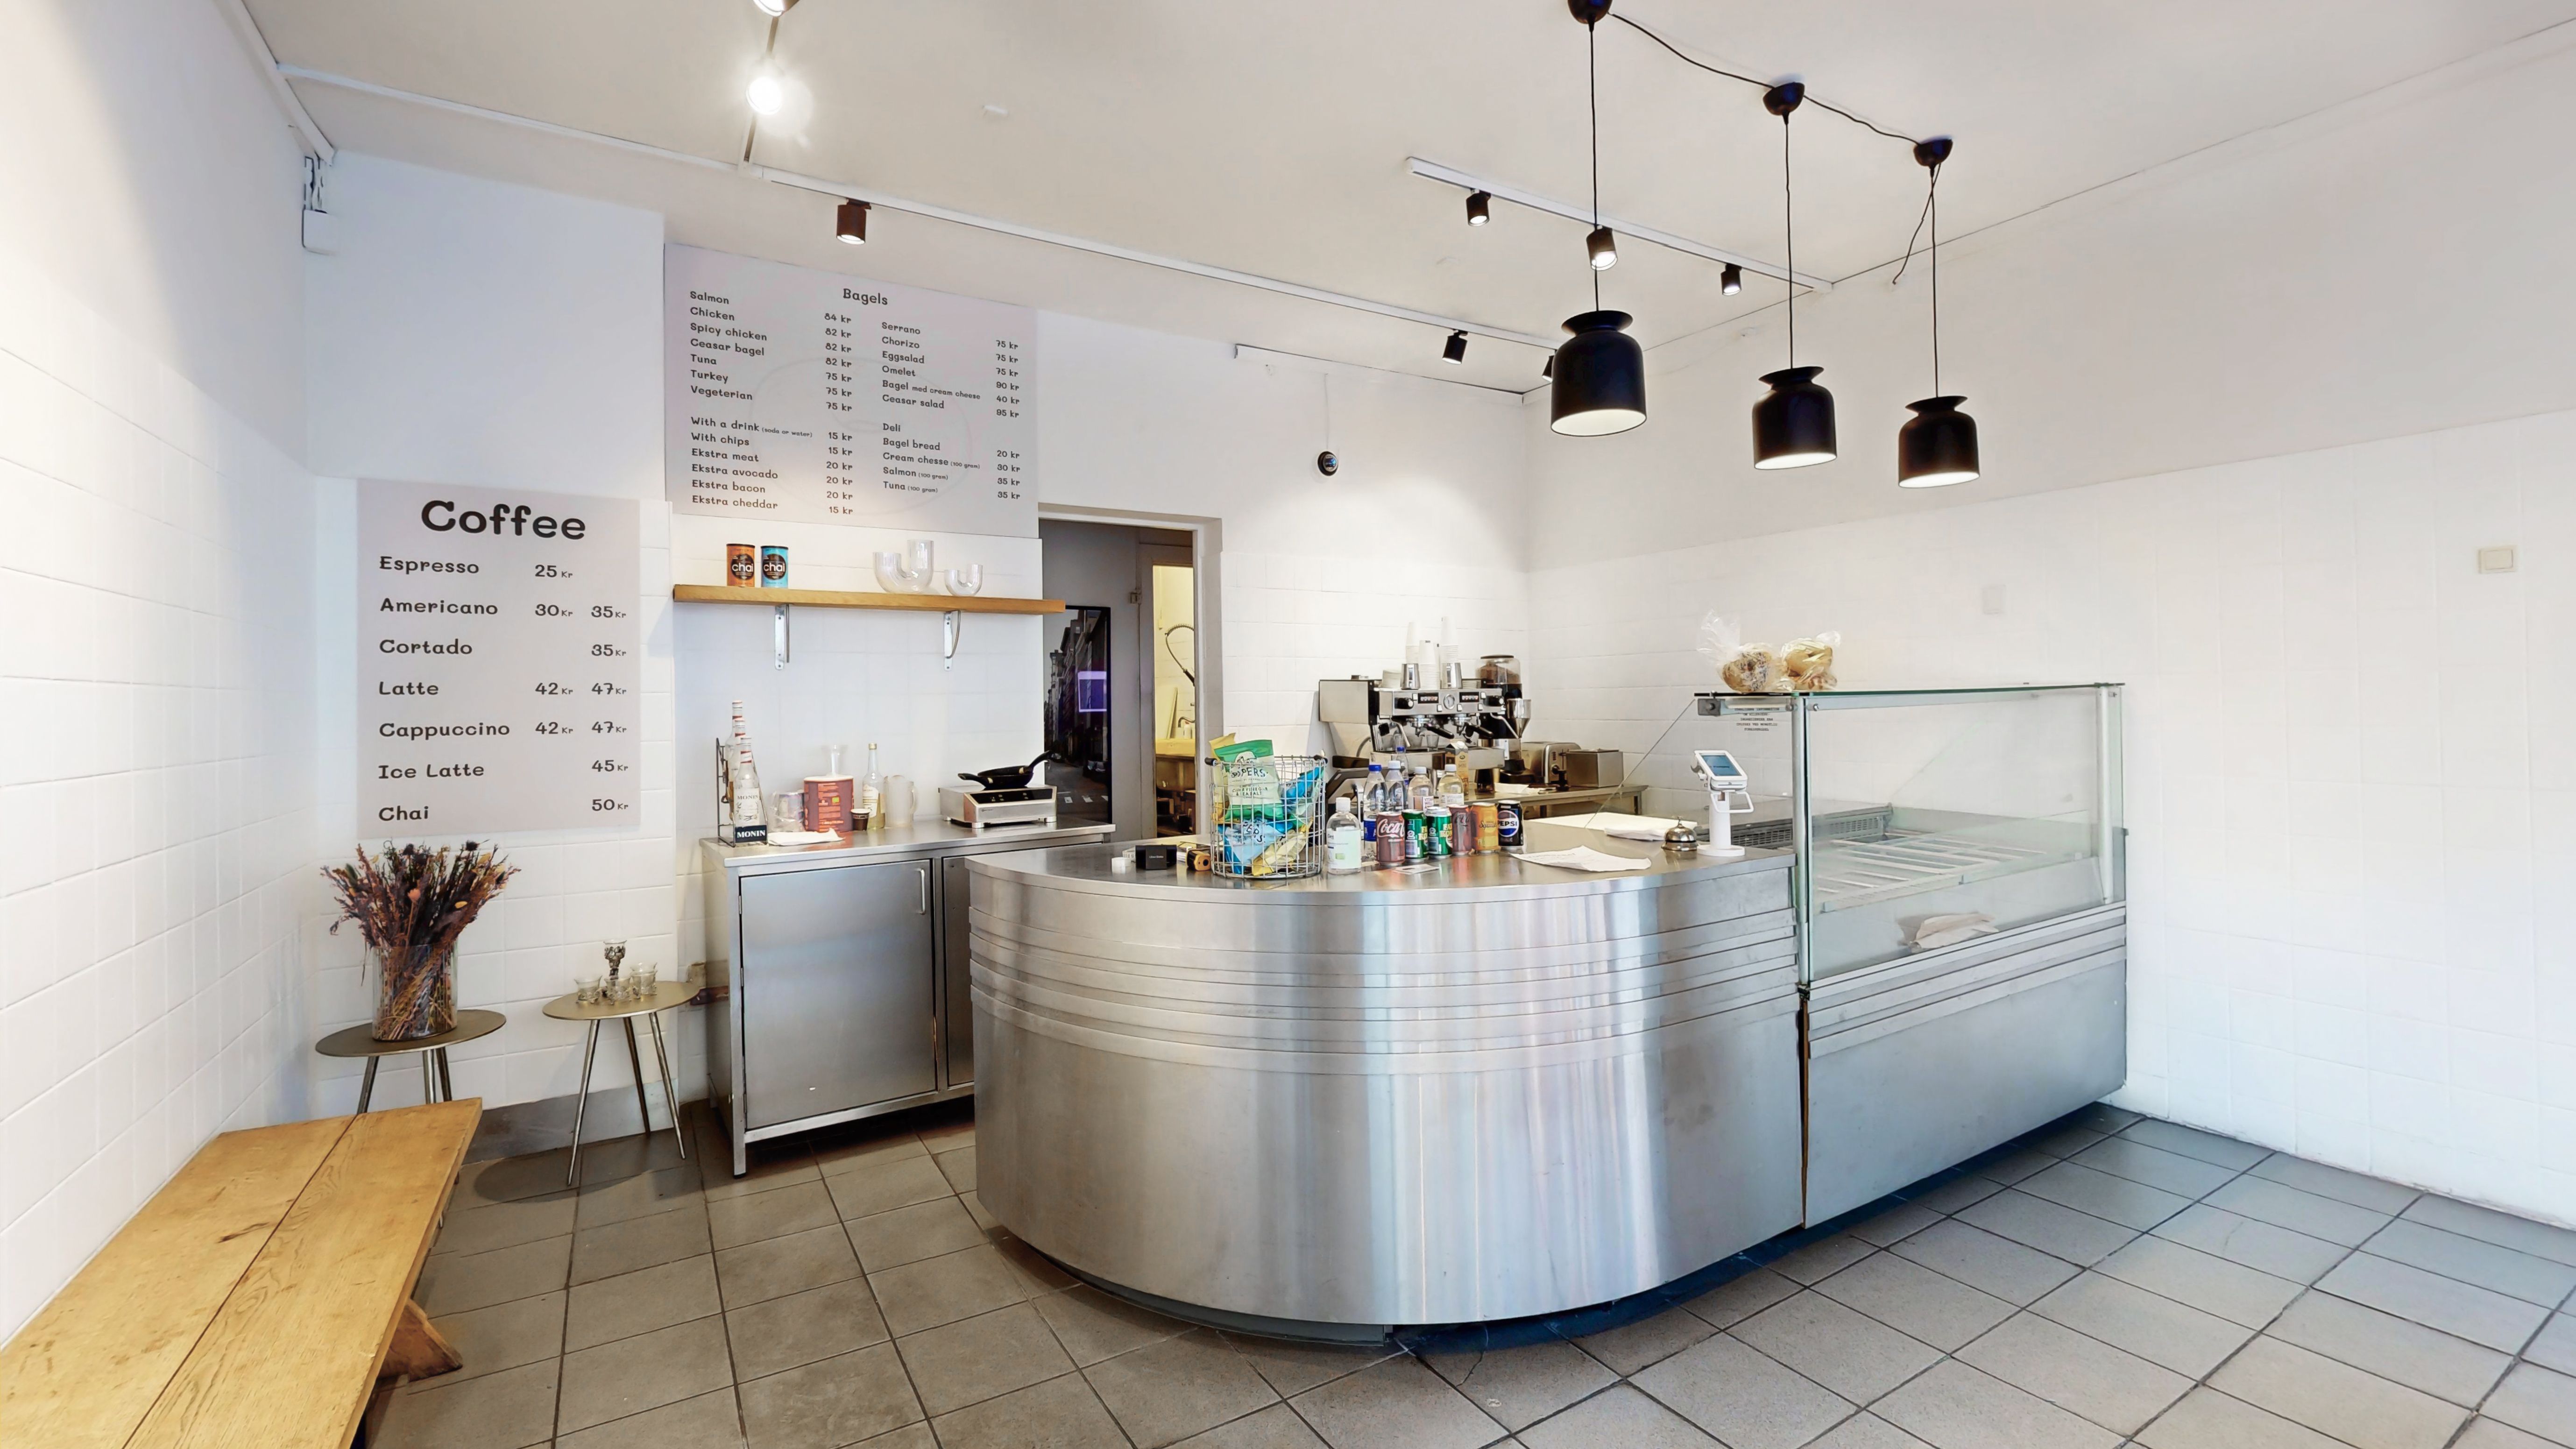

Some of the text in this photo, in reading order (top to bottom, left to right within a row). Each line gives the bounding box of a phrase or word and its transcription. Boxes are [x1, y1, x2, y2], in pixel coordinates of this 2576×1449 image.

[690, 291, 729, 304] Salmon
[843, 288, 888, 305] Bagels
[690, 307, 735, 321] Chicken
[824, 313, 851, 324] 84 kr
[690, 322, 767, 341] Spicy chicken
[825, 328, 851, 338] 82 kr
[882, 322, 920, 334] Serrano
[690, 338, 764, 357] Ceasar bagel
[825, 342, 852, 353] 82 kr
[882, 336, 920, 349] Chorizo
[1009, 341, 1018, 350] kr
[690, 353, 717, 365] Tuna
[825, 357, 852, 368] 82 kr
[882, 350, 925, 364] Eggsalad
[996, 353, 1006, 362] 75
[690, 369, 728, 384] Turkey
[826, 372, 852, 382] 75 kr
[882, 365, 916, 377] Omelet
[691, 385, 752, 400] Vegeterian
[826, 387, 852, 397] 75 kr
[882, 380, 908, 391] Bagel
[955, 390, 980, 400] cheese
[1010, 382, 1019, 391] kr
[826, 402, 852, 412] 75 kr
[882, 394, 944, 409] Ceasar salad
[1010, 410, 1019, 418] kr
[691, 416, 716, 427] With
[731, 420, 759, 431] drink
[883, 423, 900, 432] Deli
[691, 432, 750, 447] With chips
[828, 431, 852, 441] 15 kr
[883, 438, 940, 451] Bagel bread
[692, 448, 728, 459] Ekstra
[842, 447, 853, 456] kr
[883, 452, 914, 462] Cream
[918, 455, 948, 466] chesse
[692, 464, 778, 479] Ekstra avocado
[826, 461, 853, 471] 20 kr
[883, 467, 916, 477] Salmon
[692, 479, 765, 493] Ekstra bacon
[842, 477, 853, 485] kr
[883, 481, 906, 490] Tuna
[692, 495, 778, 509] Ekstra cheddar
[842, 492, 853, 500] kr
[843, 506, 853, 515] kr
[421, 500, 586, 540] Coffee
[379, 556, 479, 575] Espresso
[535, 564, 557, 578] 25
[732, 562, 753, 572] chai
[764, 562, 785, 572] chai
[380, 598, 498, 615] Americano
[535, 603, 559, 616] 30
[591, 605, 613, 618] 35
[379, 638, 473, 655] Cortado
[591, 644, 614, 657] 35
[379, 681, 439, 695] Latte
[535, 682, 559, 695] 42
[591, 683, 614, 695] 47
[379, 722, 510, 741] Cappuccino
[535, 721, 559, 735] 42
[591, 721, 614, 734] 47
[378, 763, 484, 779] Ice Latte
[592, 759, 615, 772] 45
[592, 799, 615, 812] 50
[378, 805, 429, 821] Chai
[736, 829, 766, 838] MONIN
